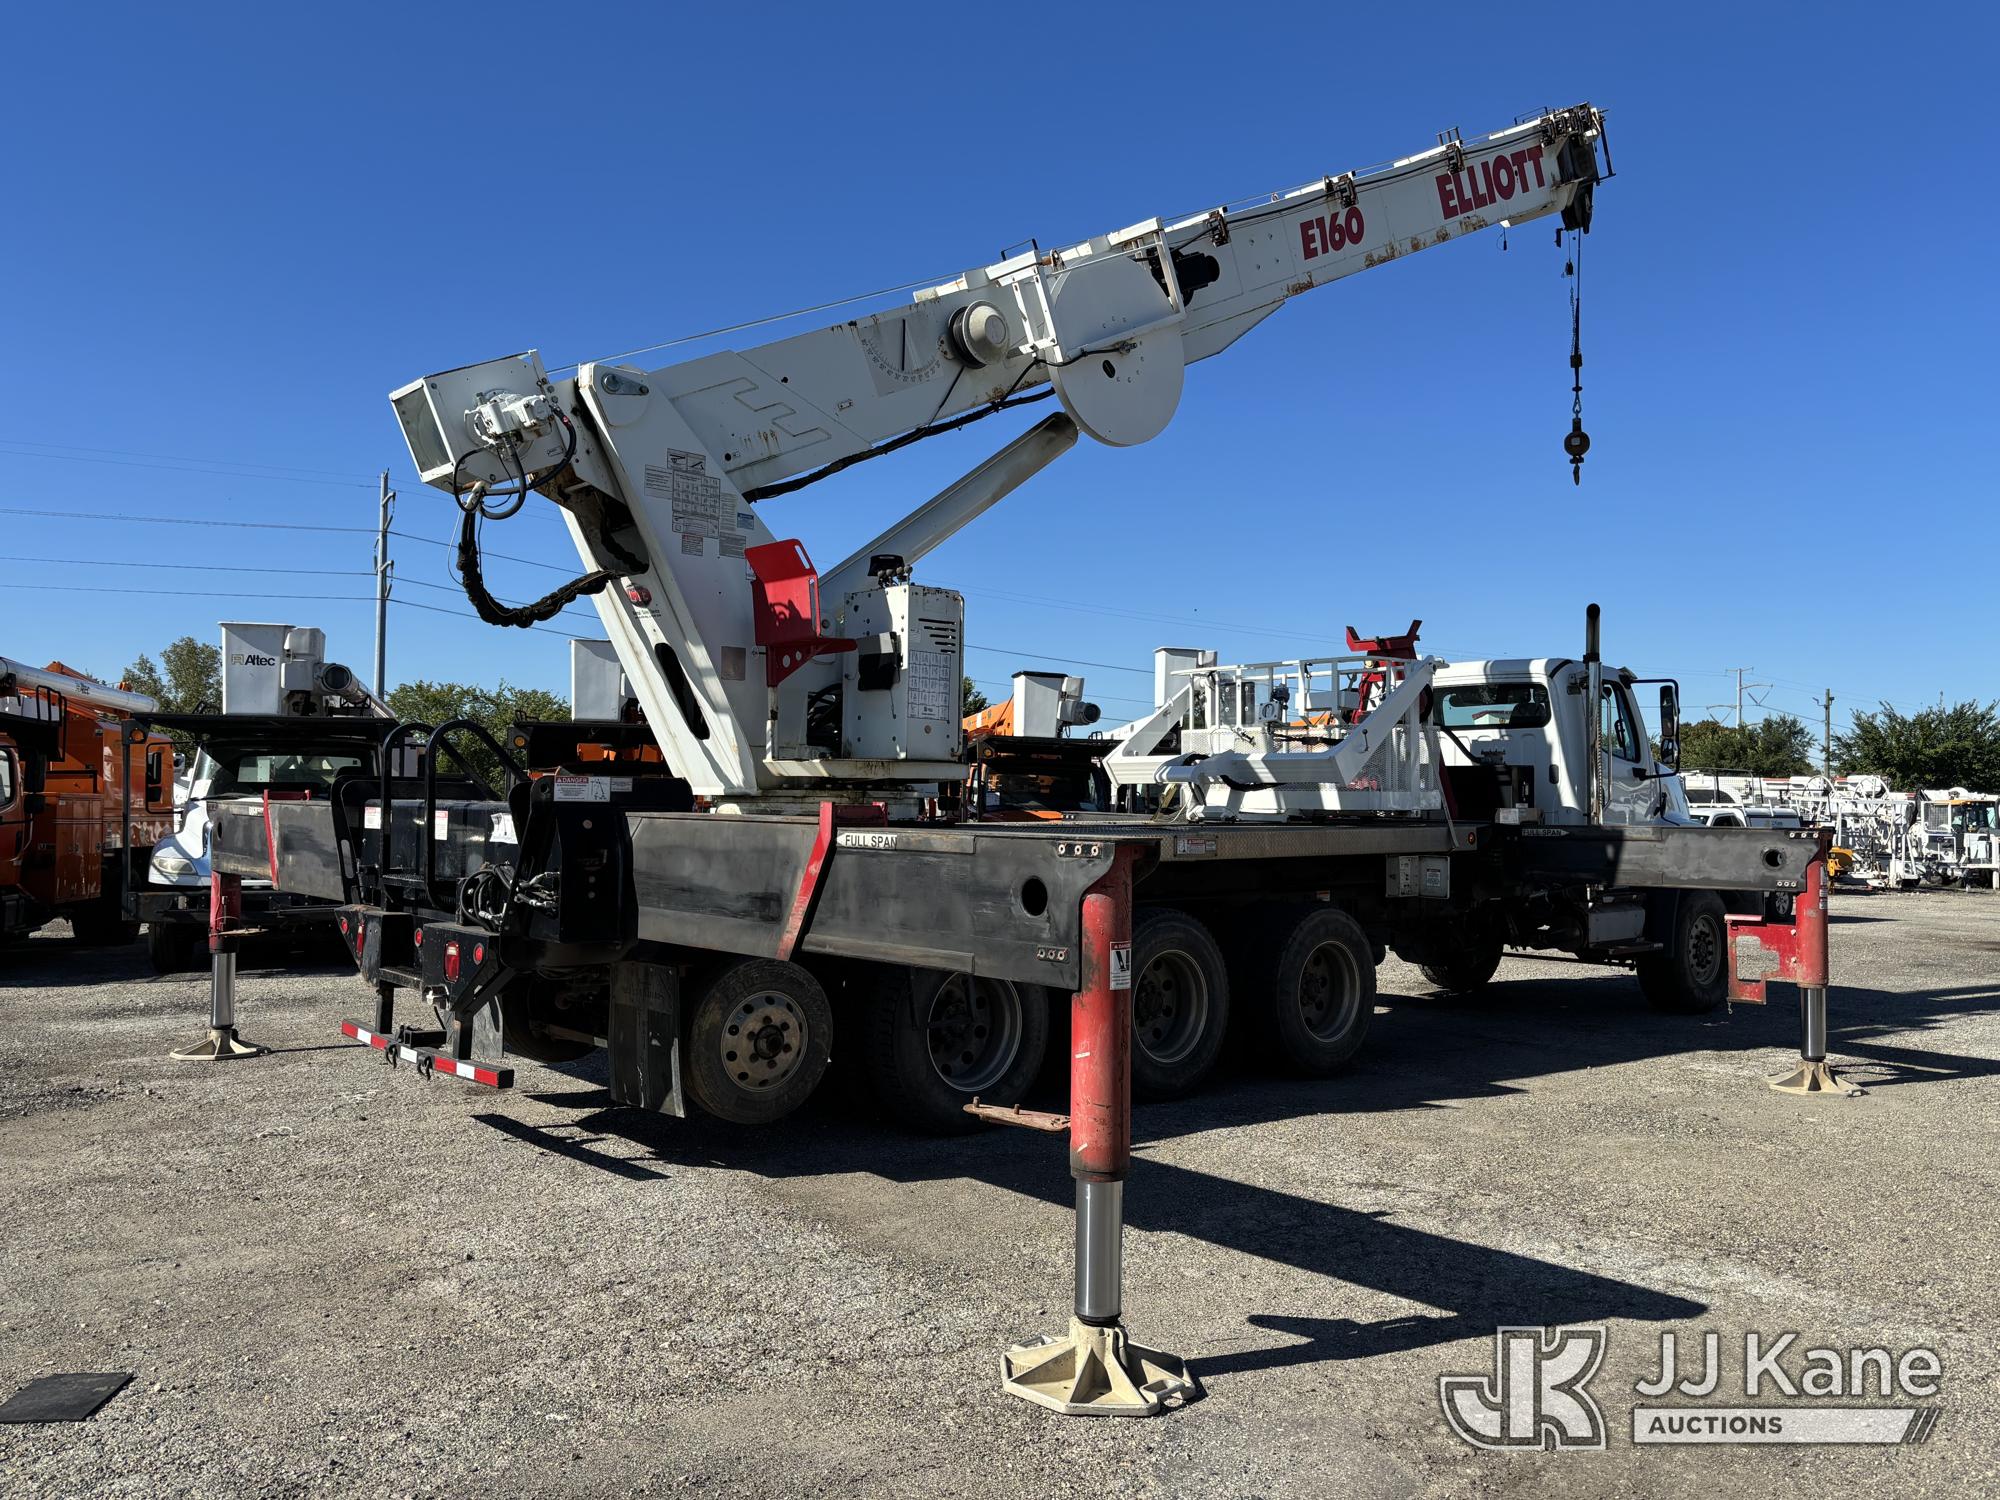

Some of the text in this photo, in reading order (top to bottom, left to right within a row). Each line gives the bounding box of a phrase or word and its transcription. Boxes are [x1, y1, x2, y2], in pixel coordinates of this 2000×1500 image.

[1436, 145, 1546, 220] ELLIOTT
[1300, 206, 1365, 260] E160
[244, 654, 276, 666] Altec
[845, 834, 898, 850] FULL SPAN
